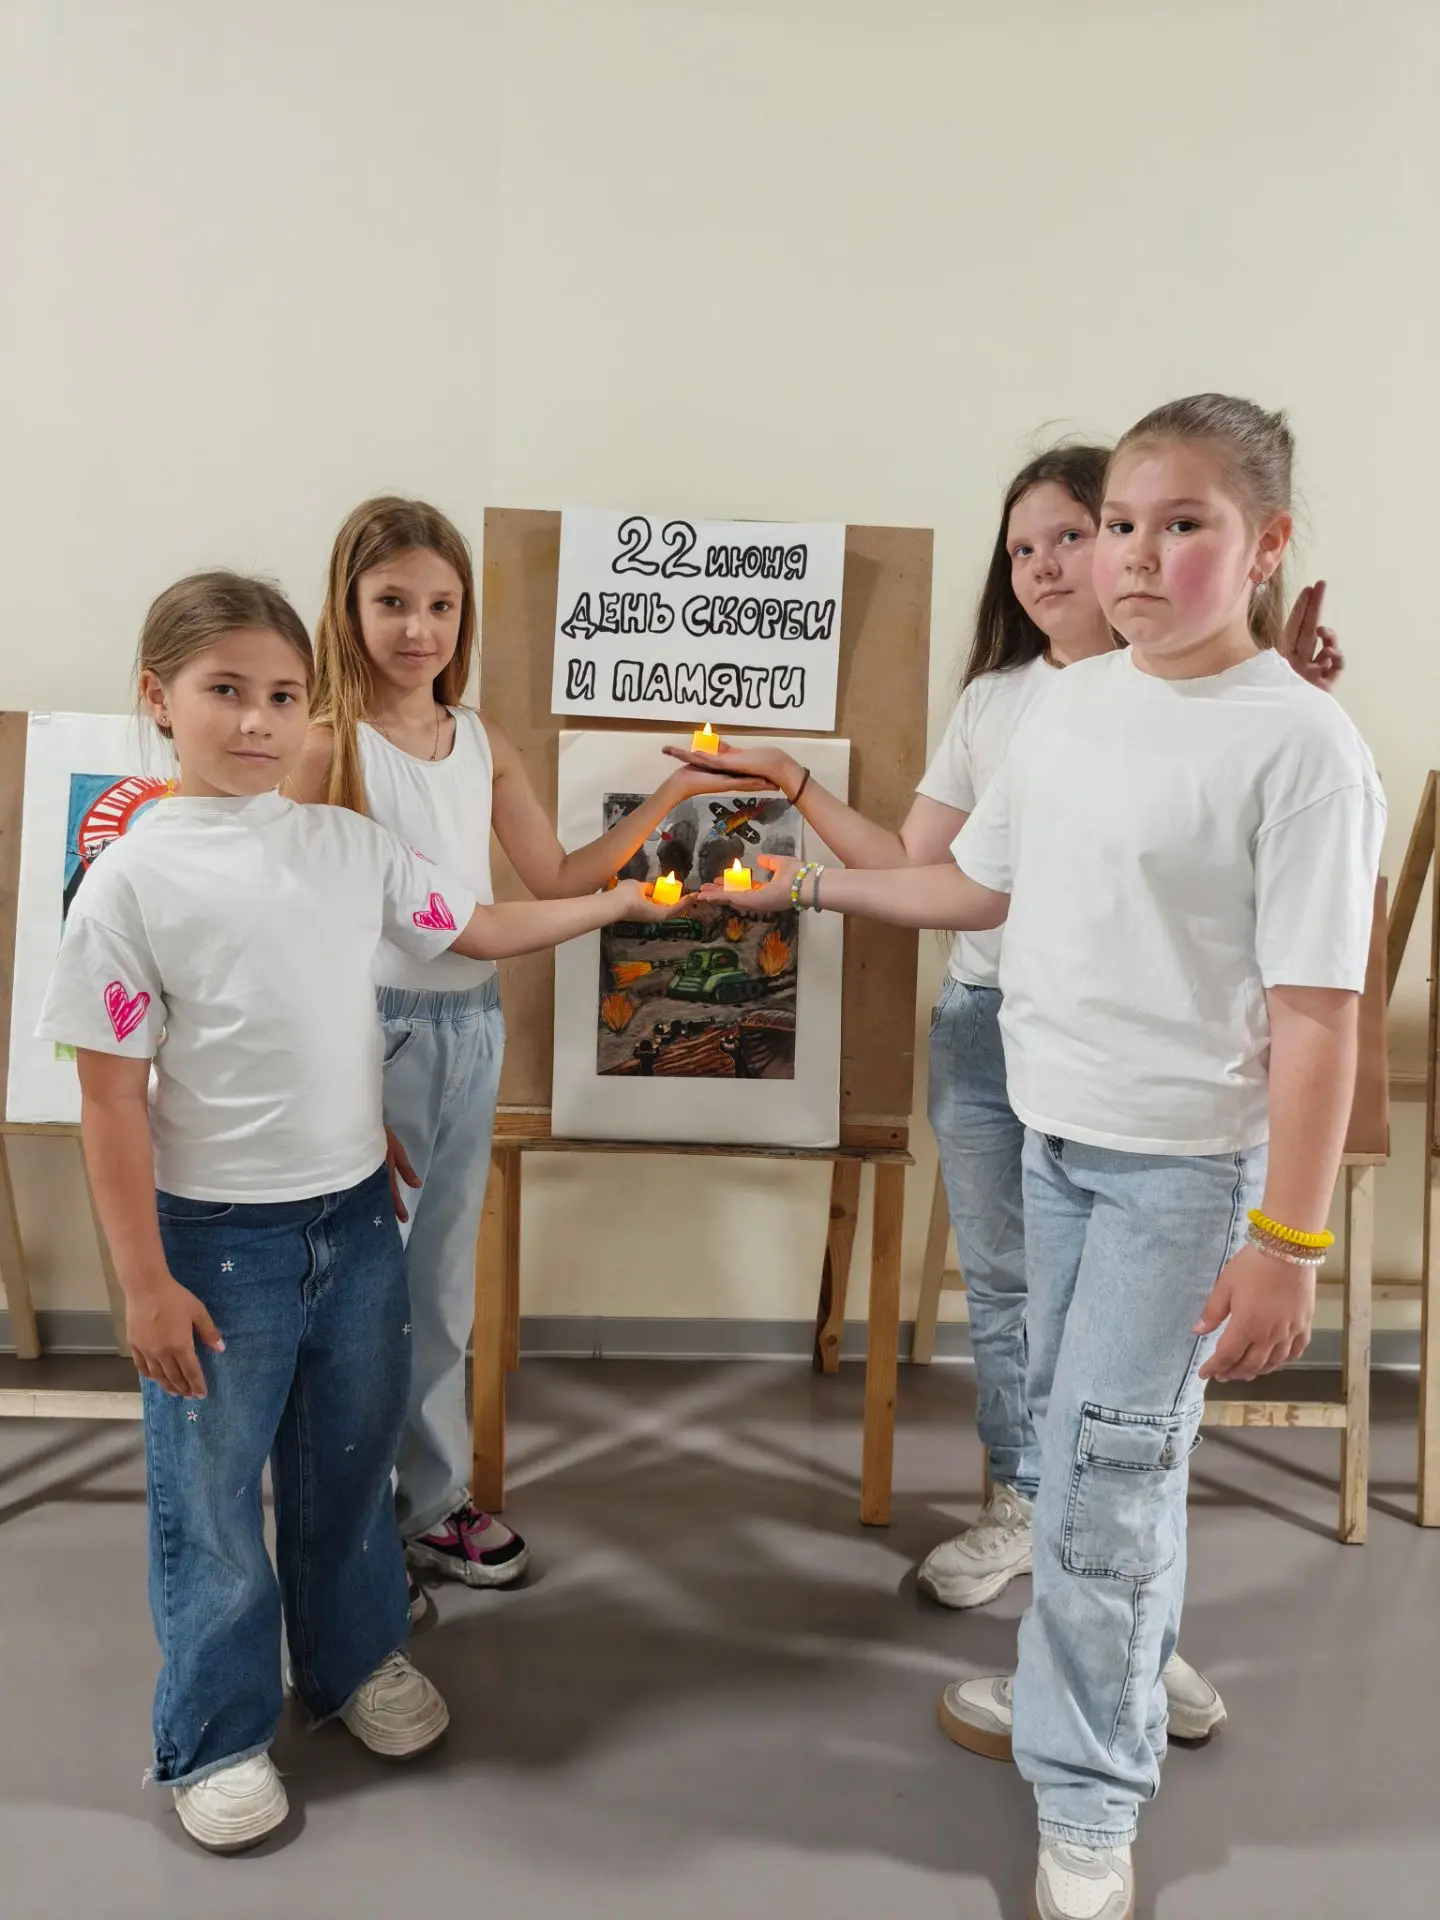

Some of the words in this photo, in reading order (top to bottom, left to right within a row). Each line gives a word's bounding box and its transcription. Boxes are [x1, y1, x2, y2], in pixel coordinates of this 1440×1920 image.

[611, 516, 702, 579] 22
[560, 591, 676, 640] ДЕНЬ
[681, 594, 836, 641] СКОРБИ
[565, 658, 596, 701] И
[611, 659, 806, 710] ПАМЯТИ
